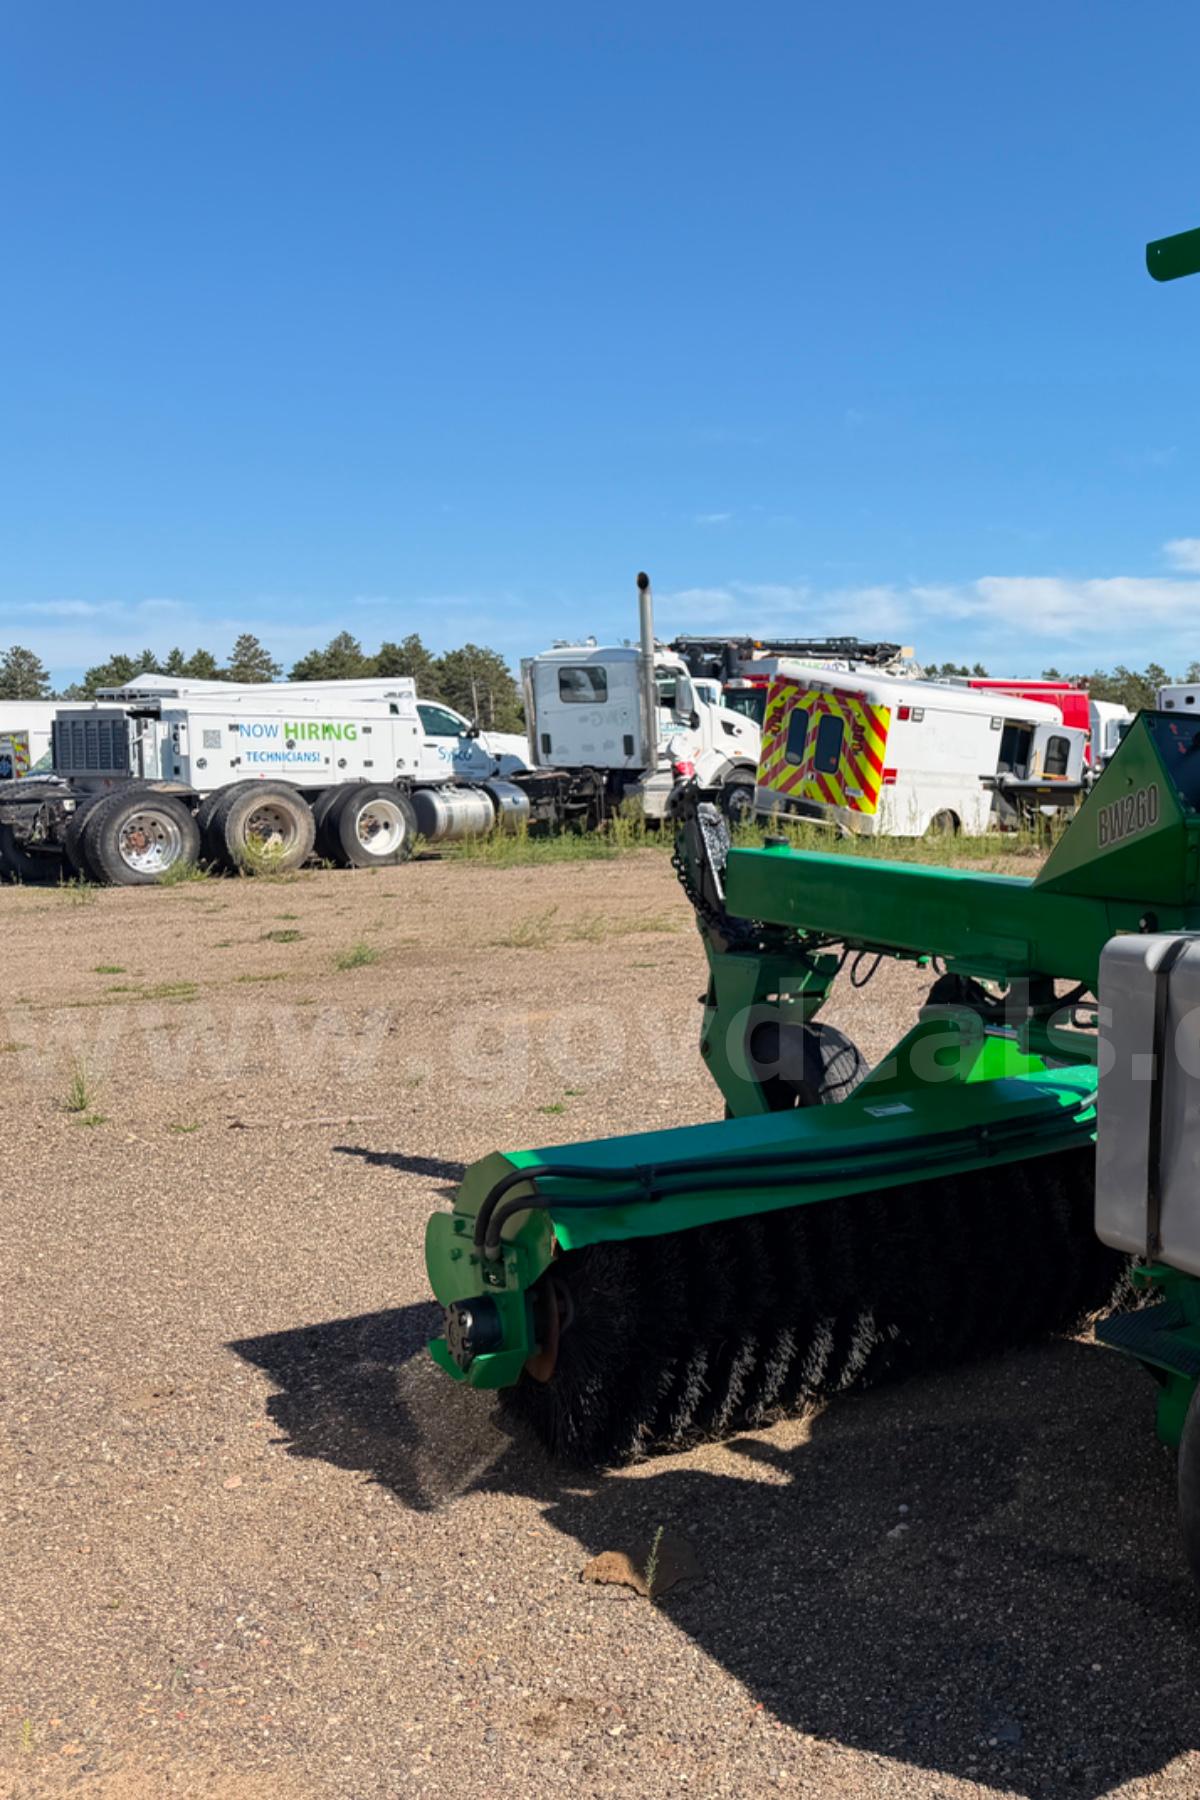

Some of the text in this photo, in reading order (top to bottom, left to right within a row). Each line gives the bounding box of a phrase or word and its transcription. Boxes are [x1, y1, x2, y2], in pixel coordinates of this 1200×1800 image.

[239, 723, 357, 741] NOW HIRING
[245, 751, 321, 763] TECHNICIANS!
[1097, 784, 1159, 849] BW260
